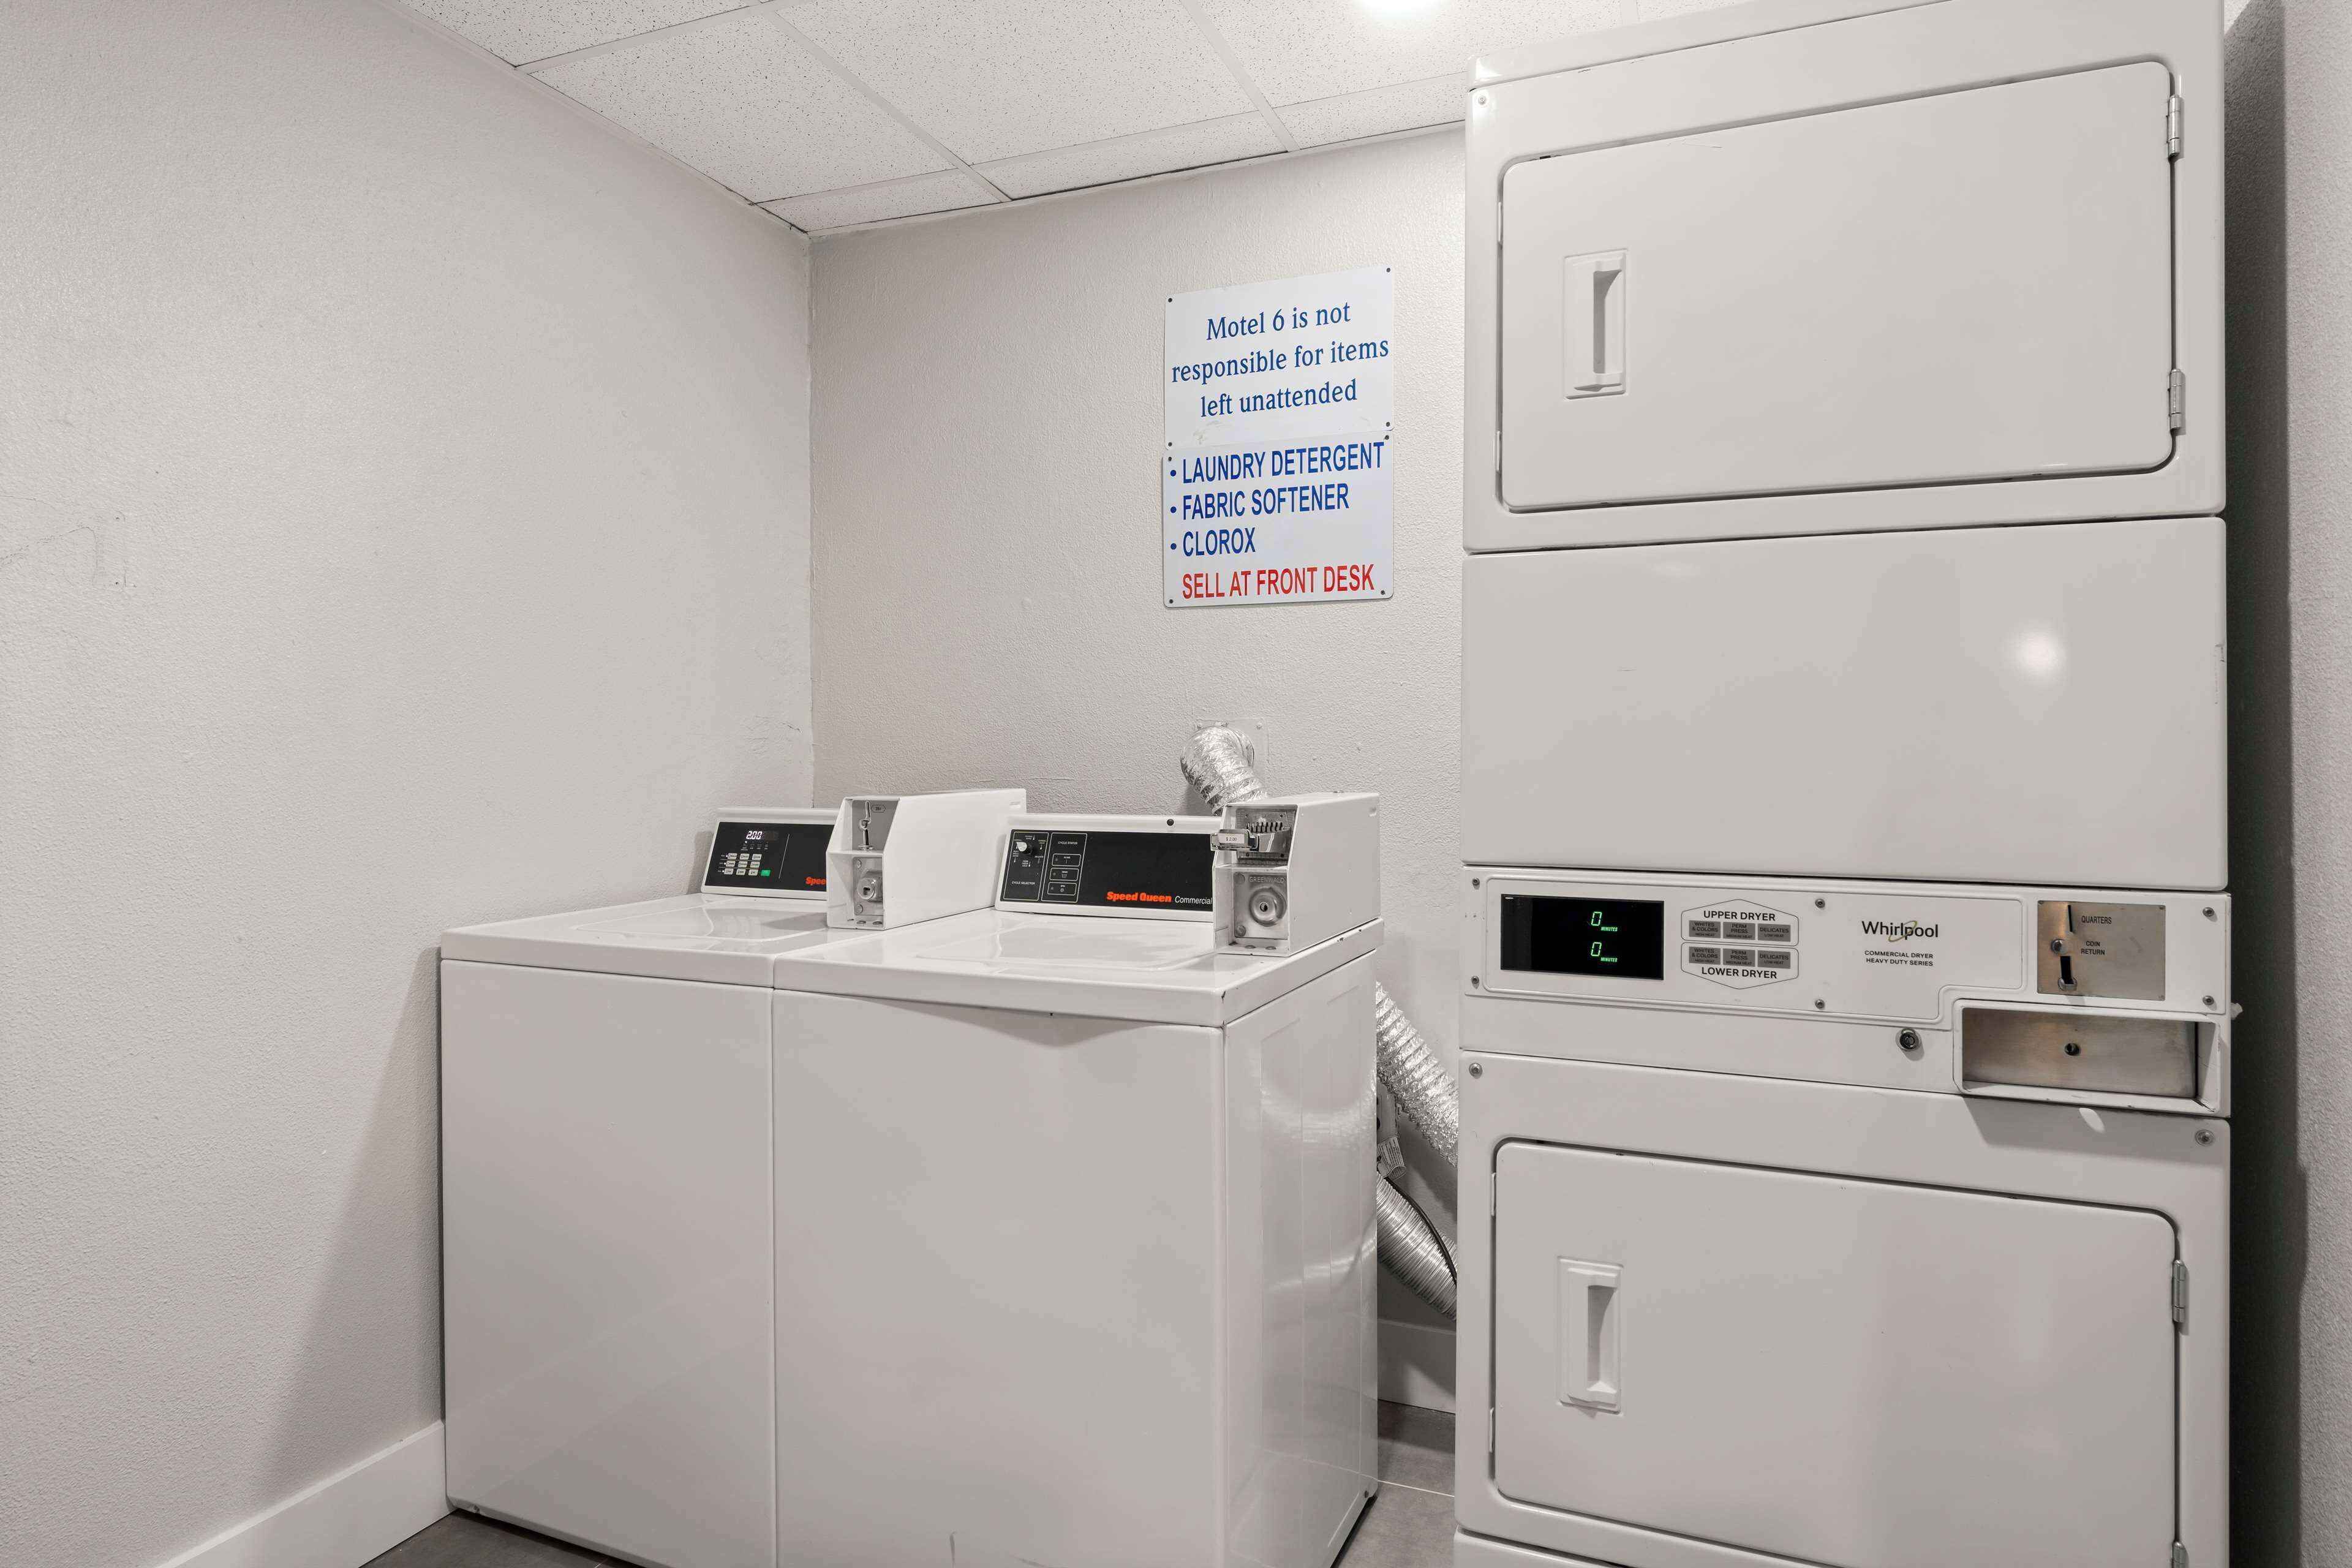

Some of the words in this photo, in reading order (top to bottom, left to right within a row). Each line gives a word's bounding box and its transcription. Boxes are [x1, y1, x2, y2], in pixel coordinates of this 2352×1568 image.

[1206, 311, 1265, 341] Motel
[1272, 308, 1285, 331] 6
[1292, 306, 1308, 330] is
[1316, 302, 1351, 326] not
[1172, 349, 1287, 385] responsible
[1294, 345, 1324, 368] for
[1330, 339, 1389, 363] items
[1200, 393, 1234, 417] left
[1239, 378, 1358, 413] unattended
[1183, 451, 1266, 484] LAUNDRY
[1272, 442, 1385, 477] DETERGENT
[1183, 490, 1246, 521] FABRIC
[1251, 483, 1350, 516] SOFTENER
[1183, 527, 1256, 557] CLOROX
[1182, 572, 1225, 600] SELL
[1229, 570, 1251, 597] AT
[1257, 567, 1318, 596] FRONT
[1324, 564, 1375, 593] DESK
[745, 831, 763, 840] 2.00
[805, 876, 826, 886] Spee
[1107, 891, 1139, 902] Speed
[1139, 892, 1172, 902] Queen
[1175, 895, 1213, 905] Commercial
[1591, 911, 1602, 926] 0
[1703, 910, 1738, 919] UPPER
[1740, 912, 1776, 921] DRYER
[2081, 915, 2112, 924] QUARTERS
[1861, 921, 1939, 941] Whirlpool
[1590, 941, 1602, 957] 0
[1702, 967, 1739, 976] LOWER
[1742, 969, 1777, 979] DRYER
